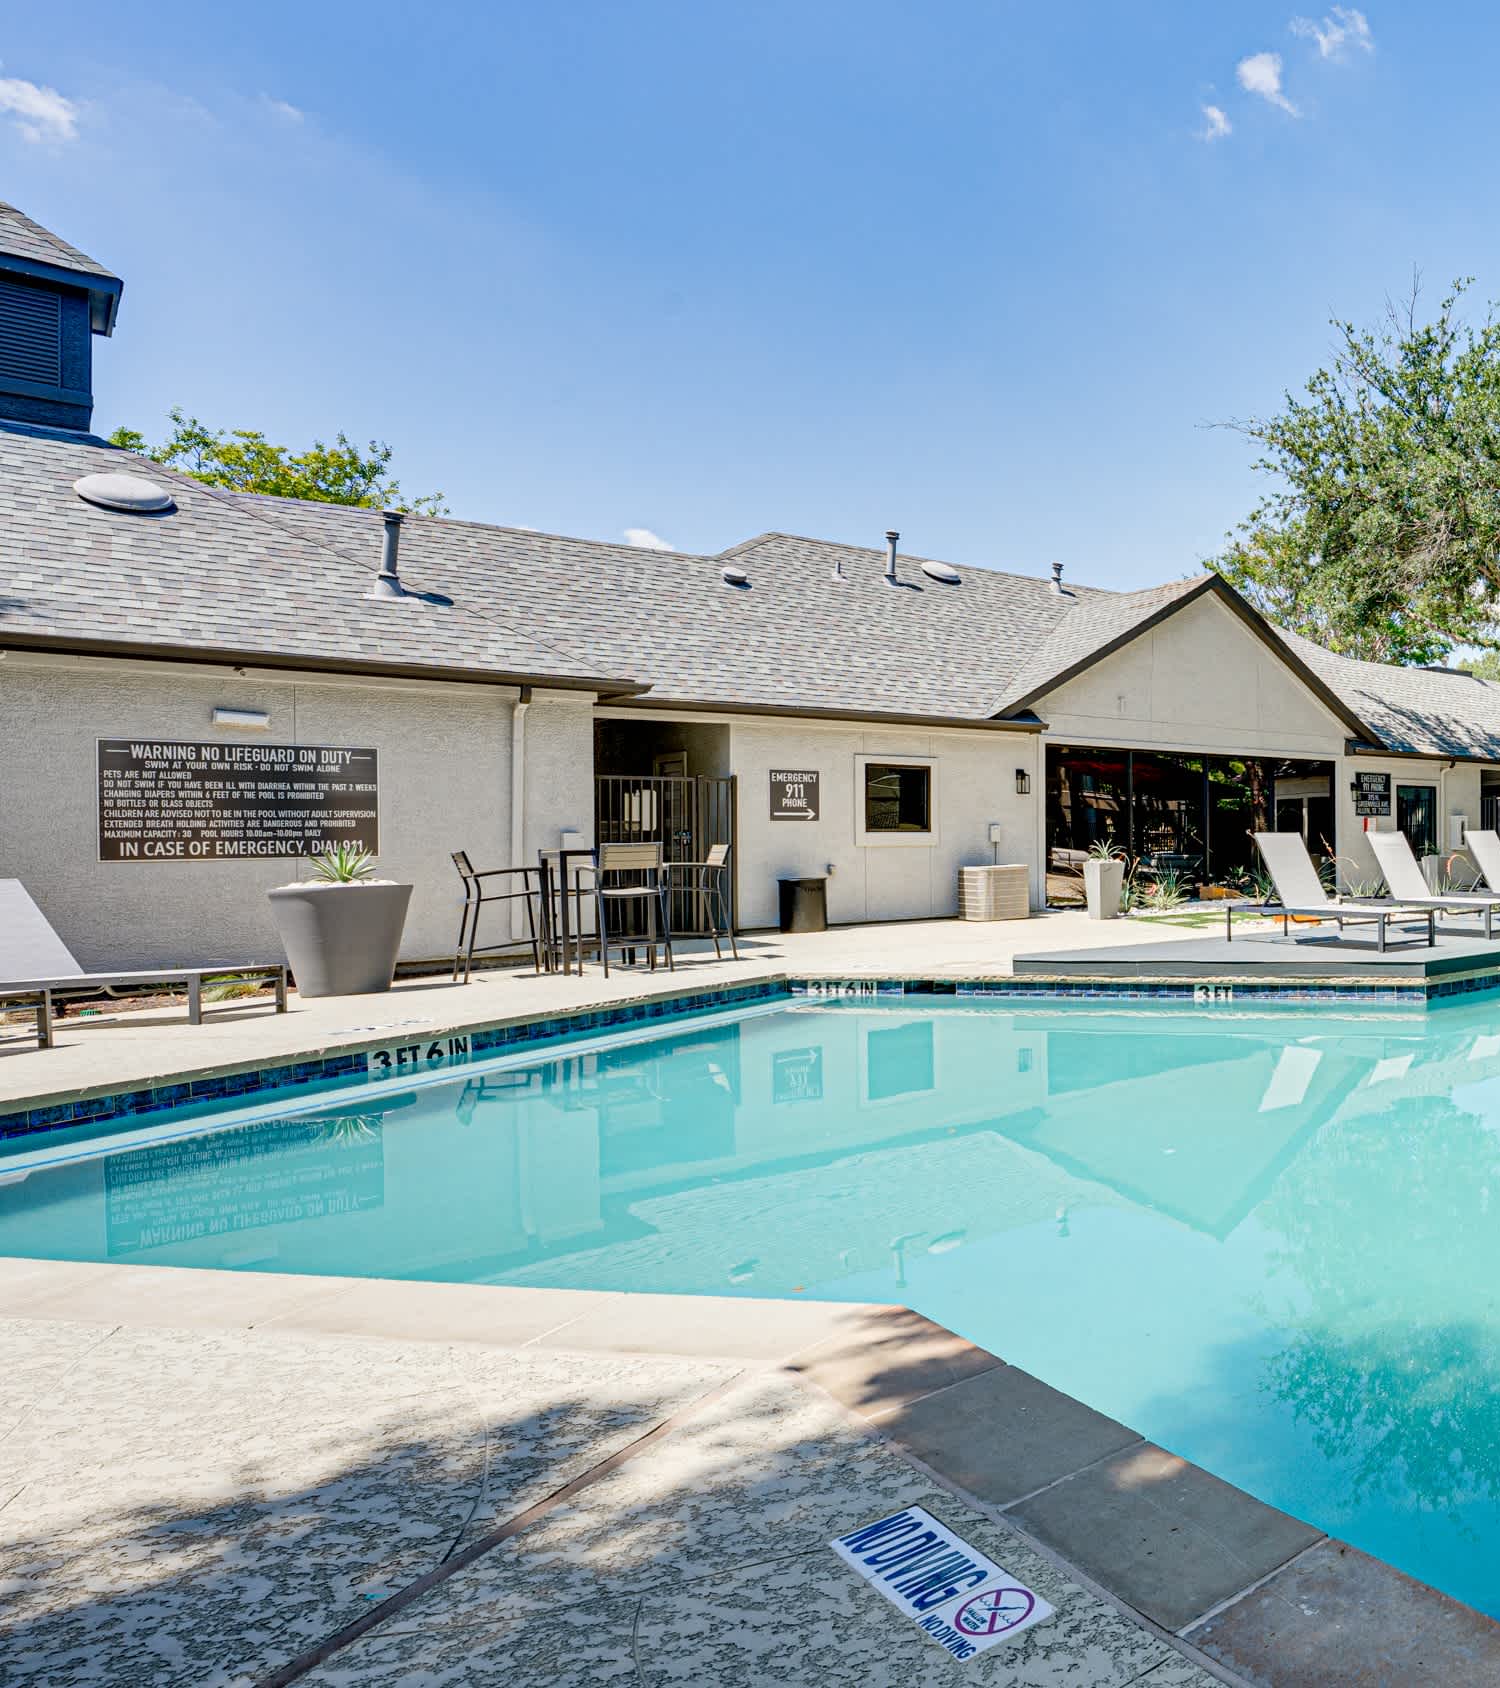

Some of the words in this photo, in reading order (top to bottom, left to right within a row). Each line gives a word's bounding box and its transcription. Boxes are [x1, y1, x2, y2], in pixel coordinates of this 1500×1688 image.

[130, 744, 196, 760] WARNING
[201, 746, 220, 760] NO
[224, 747, 295, 762] LIFEGUARD
[300, 750, 316, 764] ON
[321, 750, 352, 764] DUTY
[145, 760, 169, 769] SWIM
[172, 761, 183, 769] AT
[186, 761, 208, 770] YOUR
[211, 762, 230, 770] OWN
[234, 762, 253, 771] RISK
[260, 763, 271, 771] DO
[274, 764, 290, 772] NOT
[292, 764, 314, 772] SWIM
[316, 765, 341, 773] ALONE
[104, 770, 121, 778] PETS
[125, 770, 140, 779] ARE
[142, 771, 157, 779] NOT
[160, 771, 192, 780] ALLOWED
[772, 772, 817, 782] EMERGENCY
[104, 780, 114, 788] DO
[117, 780, 131, 788] NOT
[134, 780, 155, 788] SWIM
[168, 781, 181, 789] YOU
[184, 781, 202, 789] HAVE
[205, 781, 223, 789] BEEN
[238, 782, 255, 790] WITH
[258, 782, 290, 790] DIARRHEA
[293, 783, 316, 791] WITHIN
[318, 783, 329, 791] THE
[332, 783, 346, 791] PAST
[786, 784, 804, 798] 911
[104, 790, 141, 798] CHANGING
[144, 790, 175, 798] DIAPERS
[178, 790, 202, 798] WITHIN
[205, 790, 210, 799] 6
[212, 791, 230, 799] FEET
[232, 791, 241, 799] OF
[244, 791, 256, 799] THE
[258, 791, 276, 799] POOL
[278, 792, 285, 800] IS
[287, 792, 324, 800] PROHIBITED
[186, 800, 214, 808] OBJECTS
[782, 798, 808, 808] PHONE
[104, 810, 144, 818] CHILDREN
[144, 810, 160, 818] ARE
[161, 810, 193, 818] ADVISED
[194, 810, 210, 818] NOT
[212, 810, 221, 818] TO
[223, 810, 232, 818] BE
[234, 810, 242, 818] IN
[244, 810, 256, 818] THE
[258, 810, 277, 818] POOL
[278, 810, 310, 818] WITHOUT
[311, 810, 333, 818] ADULT
[334, 810, 376, 818] SUPERVISION
[104, 820, 143, 828] EXTENDED
[146, 820, 173, 828] BREATH
[176, 820, 207, 828] HOLDING
[209, 820, 245, 828] ACTIVITIES
[104, 830, 141, 838] MAXIMUM
[200, 830, 218, 838] POOL
[221, 830, 244, 838] HOURS
[305, 829, 321, 837] DAILY
[120, 841, 138, 856] IN
[144, 841, 184, 856] CASE
[189, 841, 210, 855] OF
[215, 840, 307, 856] EMERGENCY,
[312, 840, 339, 854] DIAL
[343, 840, 363, 853] 911
[825, 982, 842, 993] FT
[845, 982, 856, 994] 6
[860, 982, 874, 994] IN
[1198, 986, 1210, 998] 3
[1214, 986, 1231, 998] FT
[373, 1051, 392, 1069] 3
[396, 1045, 420, 1065] FT
[426, 1041, 444, 1060] 6
[448, 1036, 468, 1055] IN
[839, 1512, 923, 1554] NO
[862, 1530, 988, 1611] DIVING
[918, 1614, 944, 1631] NO
[932, 1624, 976, 1659] DIVING
